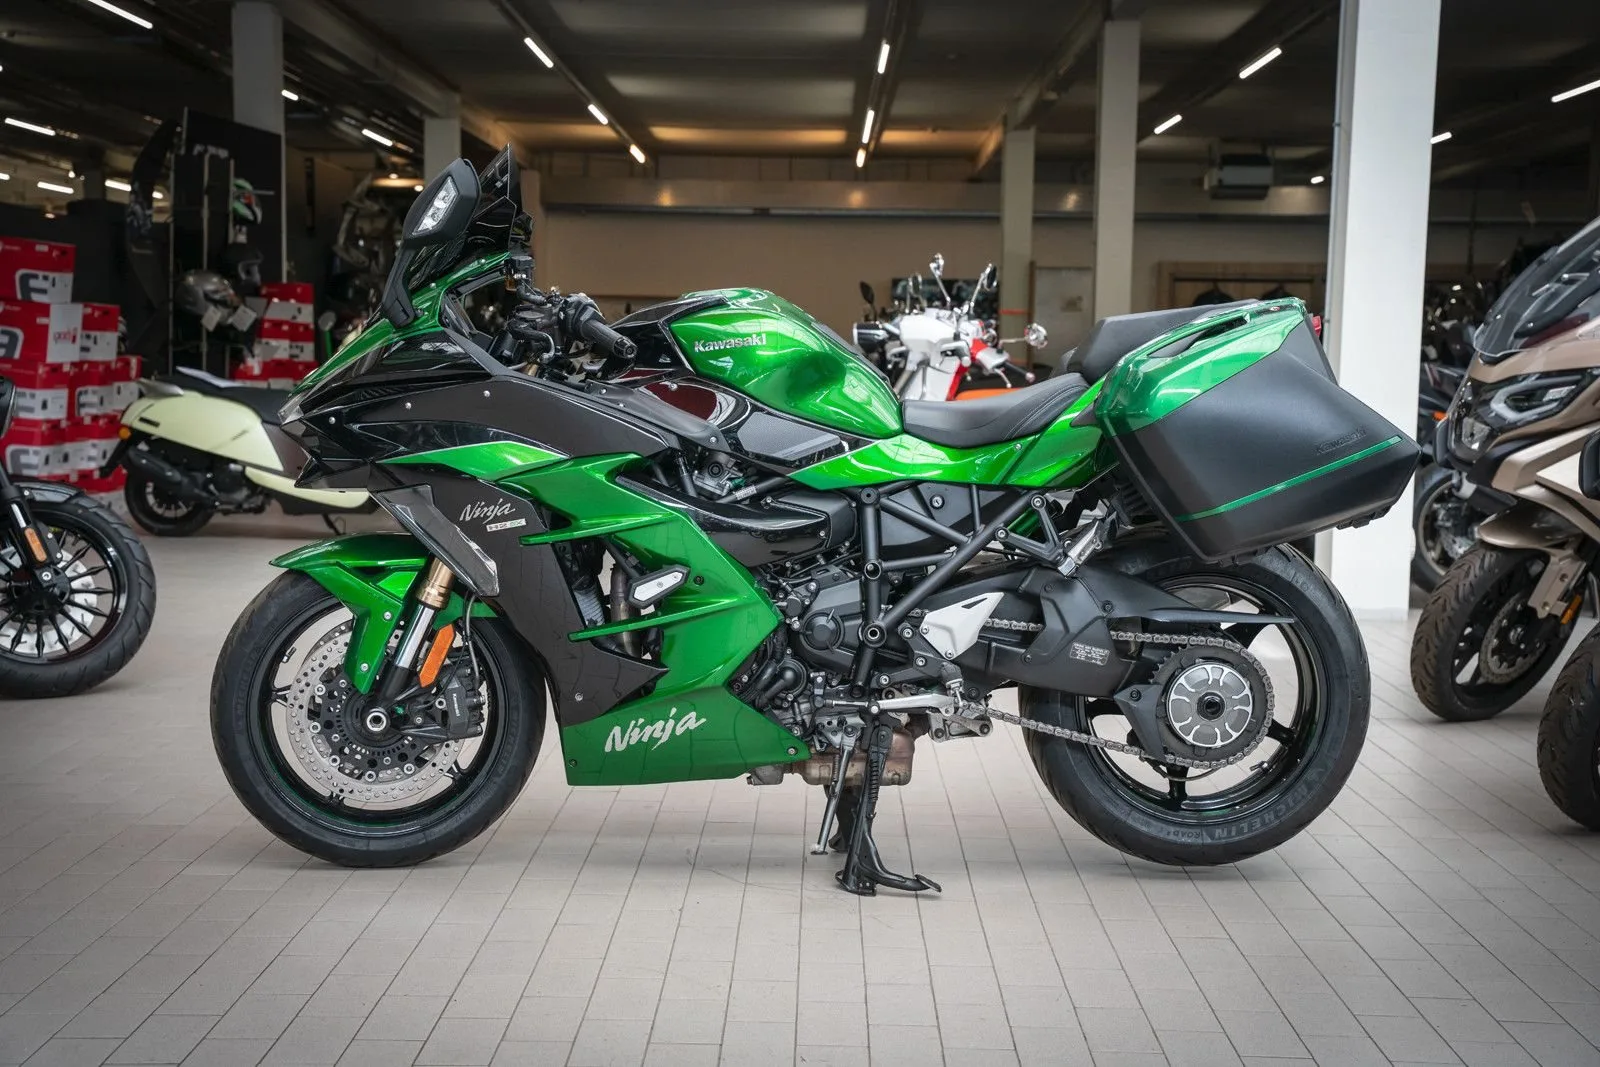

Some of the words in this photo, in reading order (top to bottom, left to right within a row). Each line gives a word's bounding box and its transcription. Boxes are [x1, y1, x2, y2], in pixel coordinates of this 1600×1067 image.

[695, 333, 767, 352] Kawasaki
[459, 498, 516, 524] Ninja
[604, 707, 707, 753] Ninja
